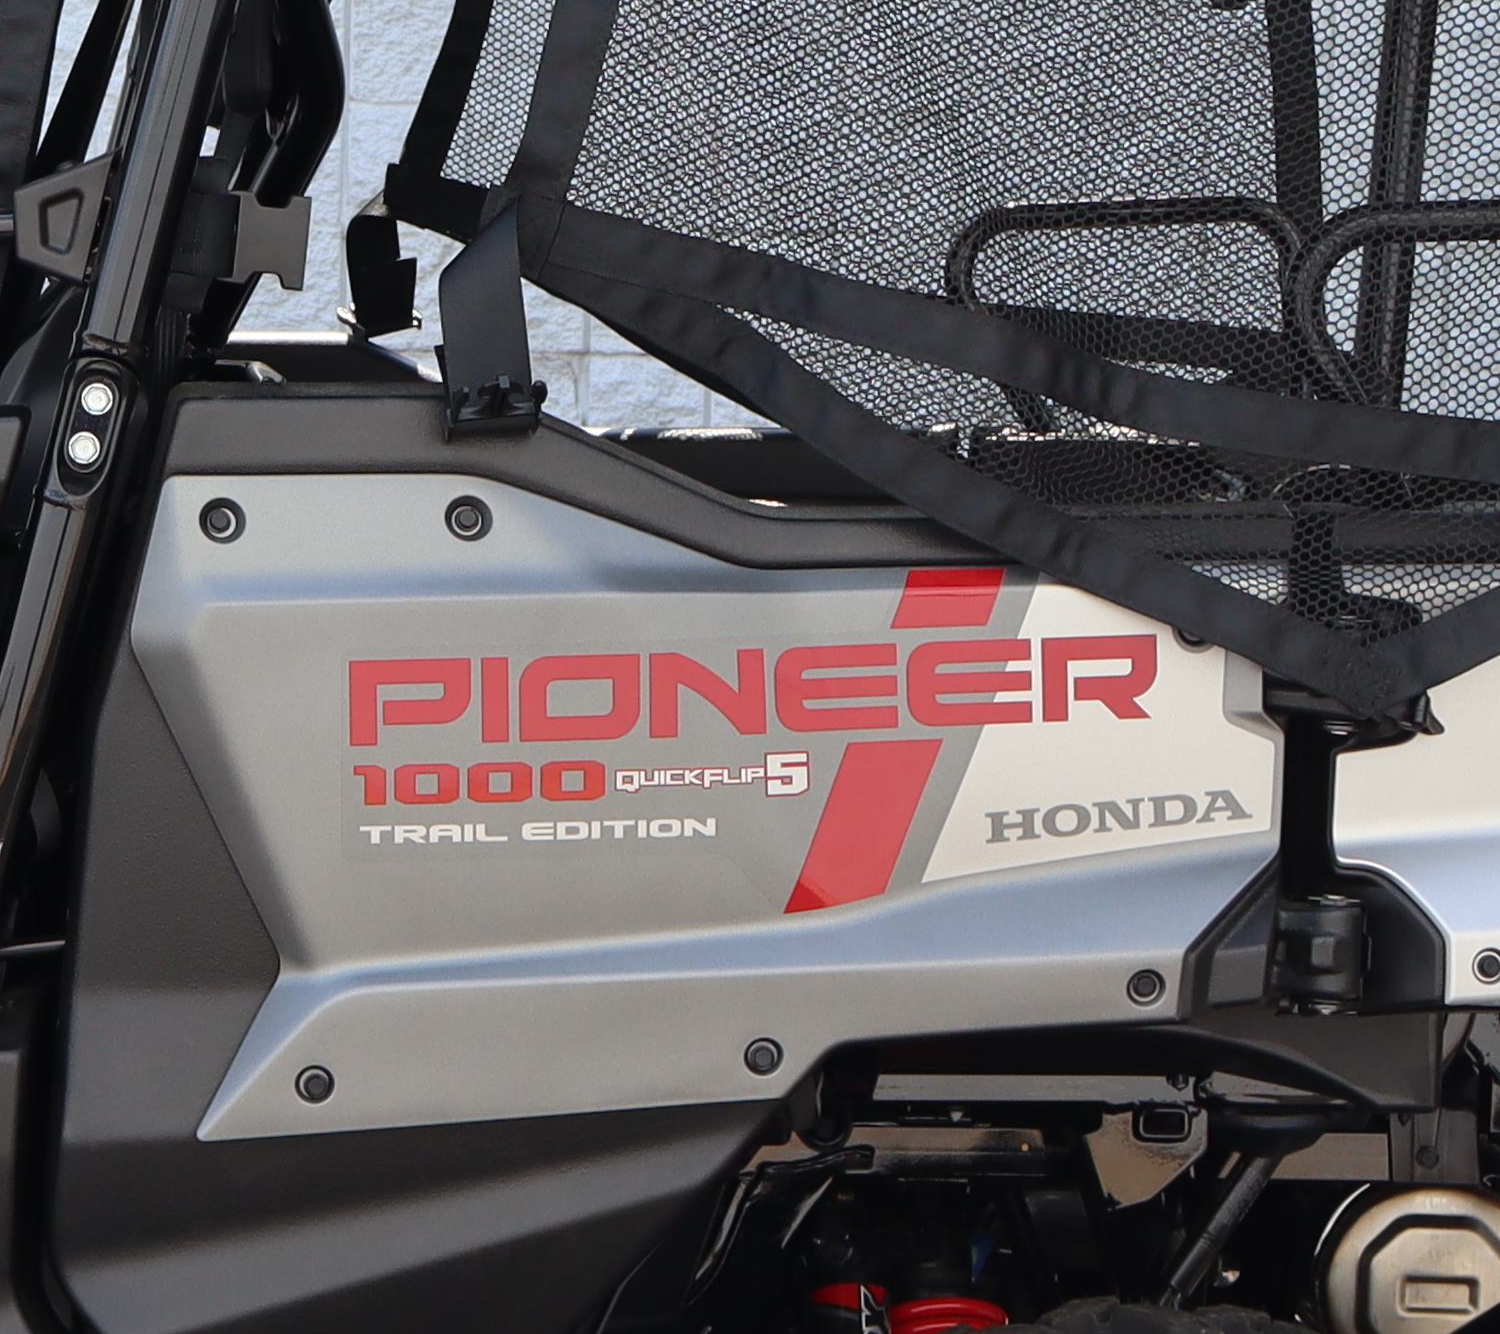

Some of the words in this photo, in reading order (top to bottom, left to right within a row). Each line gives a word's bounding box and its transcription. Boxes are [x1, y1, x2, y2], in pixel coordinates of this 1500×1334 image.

[349, 633, 1158, 746] PIONEER
[353, 760, 606, 805] 1000
[359, 823, 508, 845] TRAIL
[521, 818, 717, 842] EDITION
[984, 789, 1253, 845] HONDA
